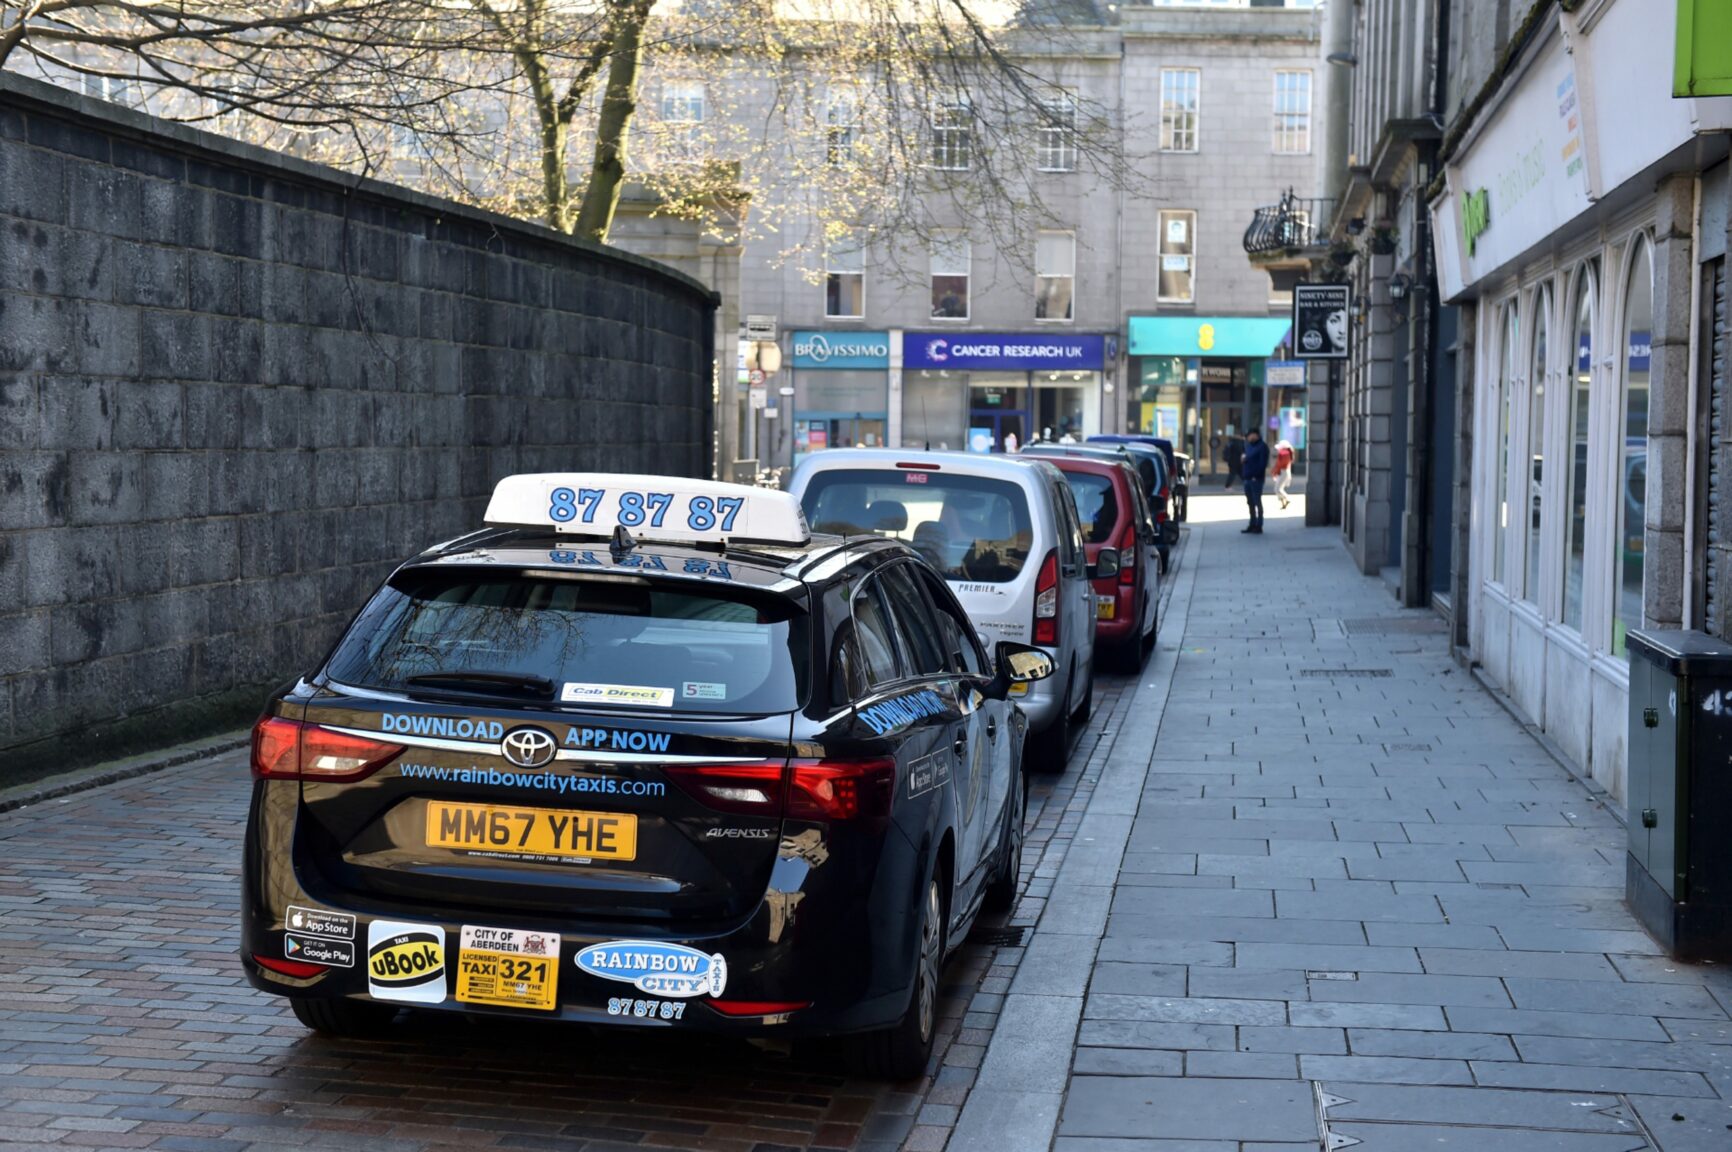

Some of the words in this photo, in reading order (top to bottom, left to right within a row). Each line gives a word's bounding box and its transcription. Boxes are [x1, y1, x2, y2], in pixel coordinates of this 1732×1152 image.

[795, 341, 887, 358] BRAVISSIMO
[951, 345, 1000, 357] CANCER
[1004, 346, 1063, 358] RESEARCH
[1066, 347, 1082, 358] UK
[549, 487, 606, 523] 87
[617, 491, 675, 527] 87
[687, 496, 745, 531] 87
[958, 584, 995, 592] PREMIER
[573, 687, 603, 695] Cab
[607, 689, 657, 699] Direct
[686, 684, 697, 696] 5
[857, 692, 929, 736] DOWNLOAD
[382, 712, 504, 739] DOWNLOAD
[564, 727, 607, 748] APP
[611, 730, 671, 752] NOW
[400, 762, 666, 797] www.rainbowcitytaxis.com
[439, 808, 538, 846] MM67
[548, 815, 618, 853] YHE
[706, 828, 770, 838] AVENSIS
[307, 912, 332, 922] Download
[306, 920, 324, 932] App
[325, 923, 349, 934] Store
[474, 929, 498, 939] CITY
[500, 931, 514, 941] OF
[470, 940, 520, 952] ABERDEEN
[303, 946, 332, 960] Google
[333, 950, 351, 963] Play
[462, 953, 498, 962] LICENSED
[591, 951, 699, 973] RAINBOW
[462, 961, 497, 976] TAXI
[500, 958, 547, 983] 321
[711, 958, 722, 992] TAXIS
[502, 981, 525, 989] MM67
[641, 976, 704, 993] CITY
